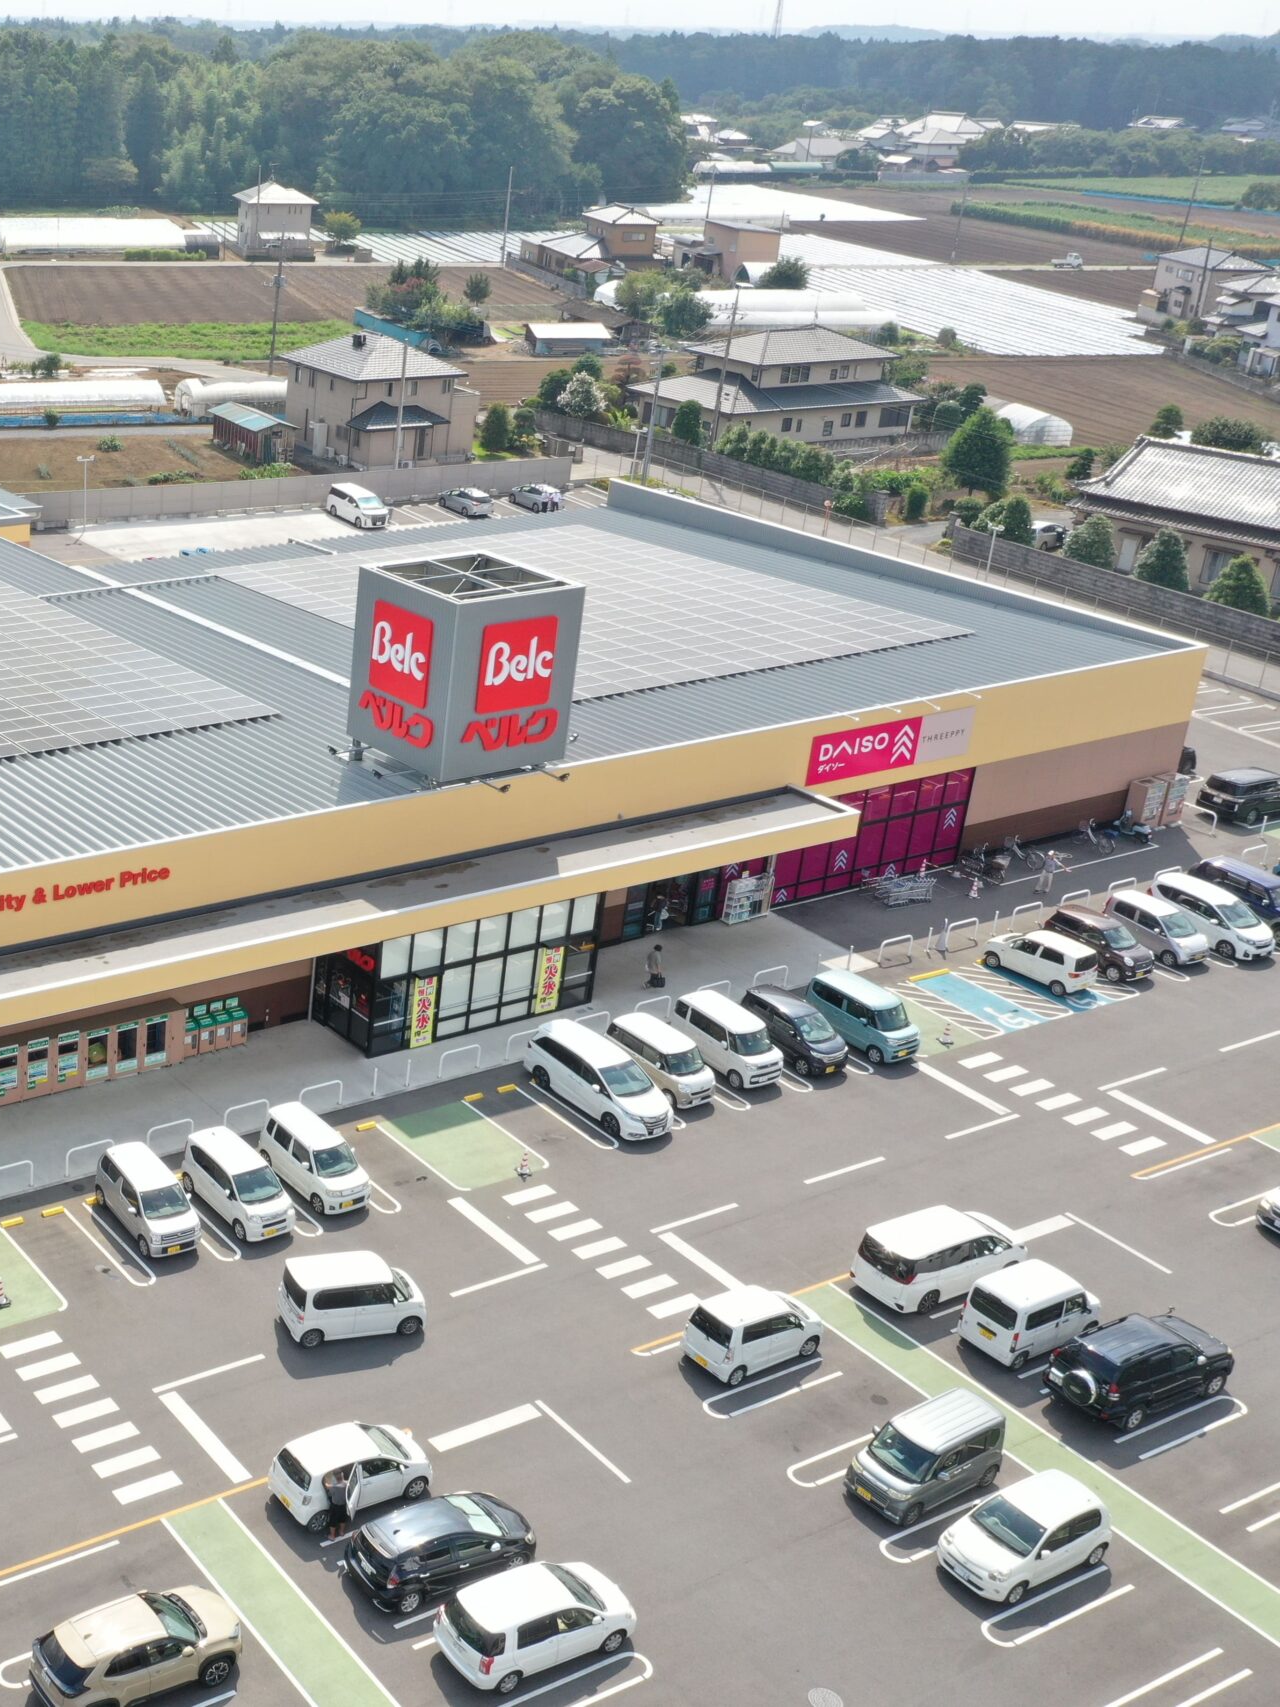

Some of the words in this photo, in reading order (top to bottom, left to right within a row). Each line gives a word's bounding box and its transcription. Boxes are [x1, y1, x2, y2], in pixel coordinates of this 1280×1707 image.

[371, 620, 426, 681] Belc
[484, 636, 553, 686] Belc
[358, 689, 434, 749] ベルク
[460, 707, 560, 752] ベルク
[922, 728, 965, 744] THREEPPY
[818, 732, 889, 762] DAISO
[817, 762, 845, 774] ダイソー
[32, 887, 47, 904] &
[53, 877, 115, 901] Lower
[119, 867, 170, 888] Price
